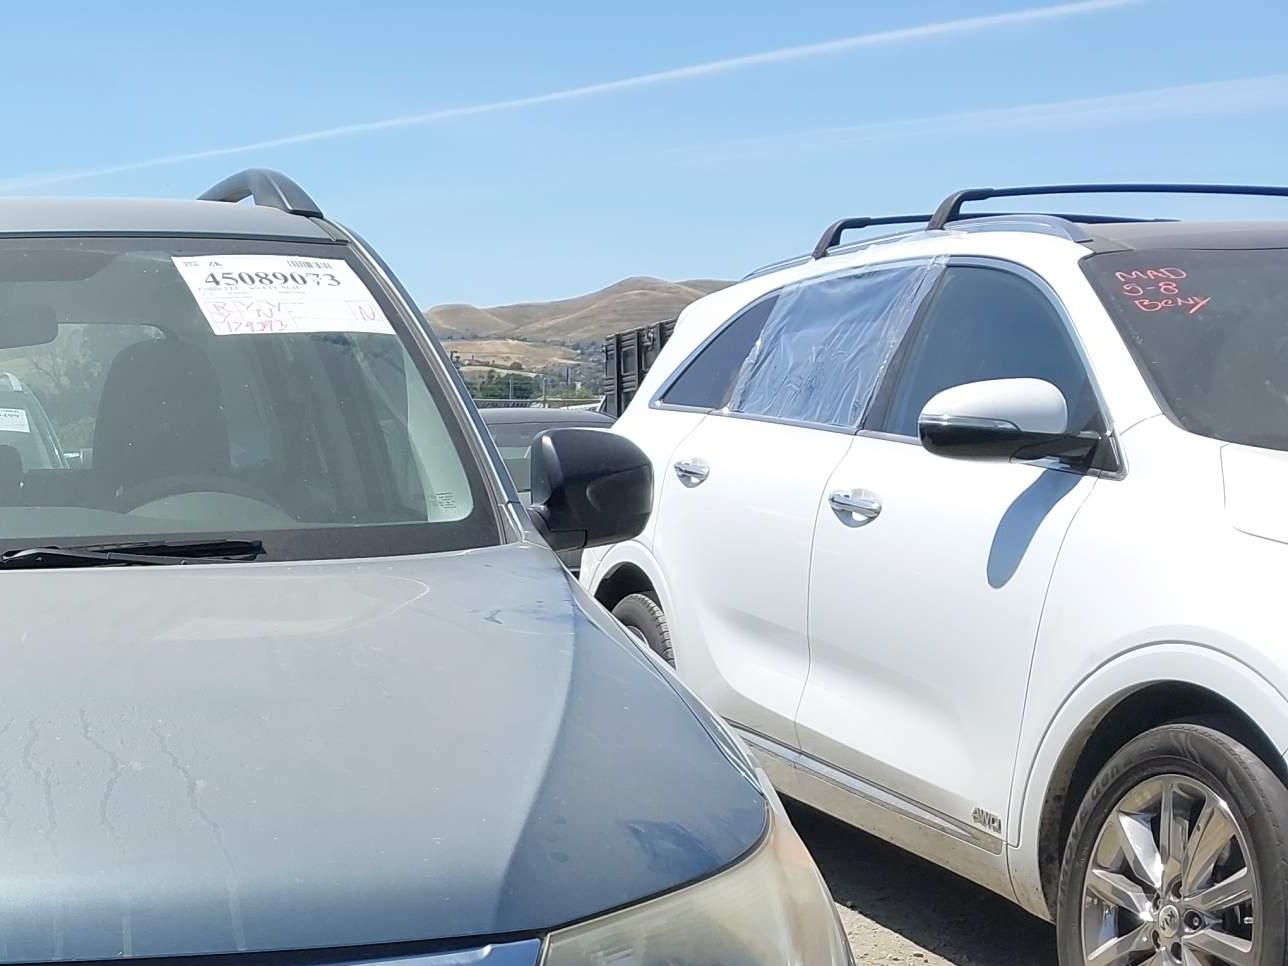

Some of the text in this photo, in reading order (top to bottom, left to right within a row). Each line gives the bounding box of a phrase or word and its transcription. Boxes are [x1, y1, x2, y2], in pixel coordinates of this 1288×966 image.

[204, 270, 341, 287] 45089073
[1115, 267, 1187, 282] MAD
[1123, 281, 1179, 296] 5-8
